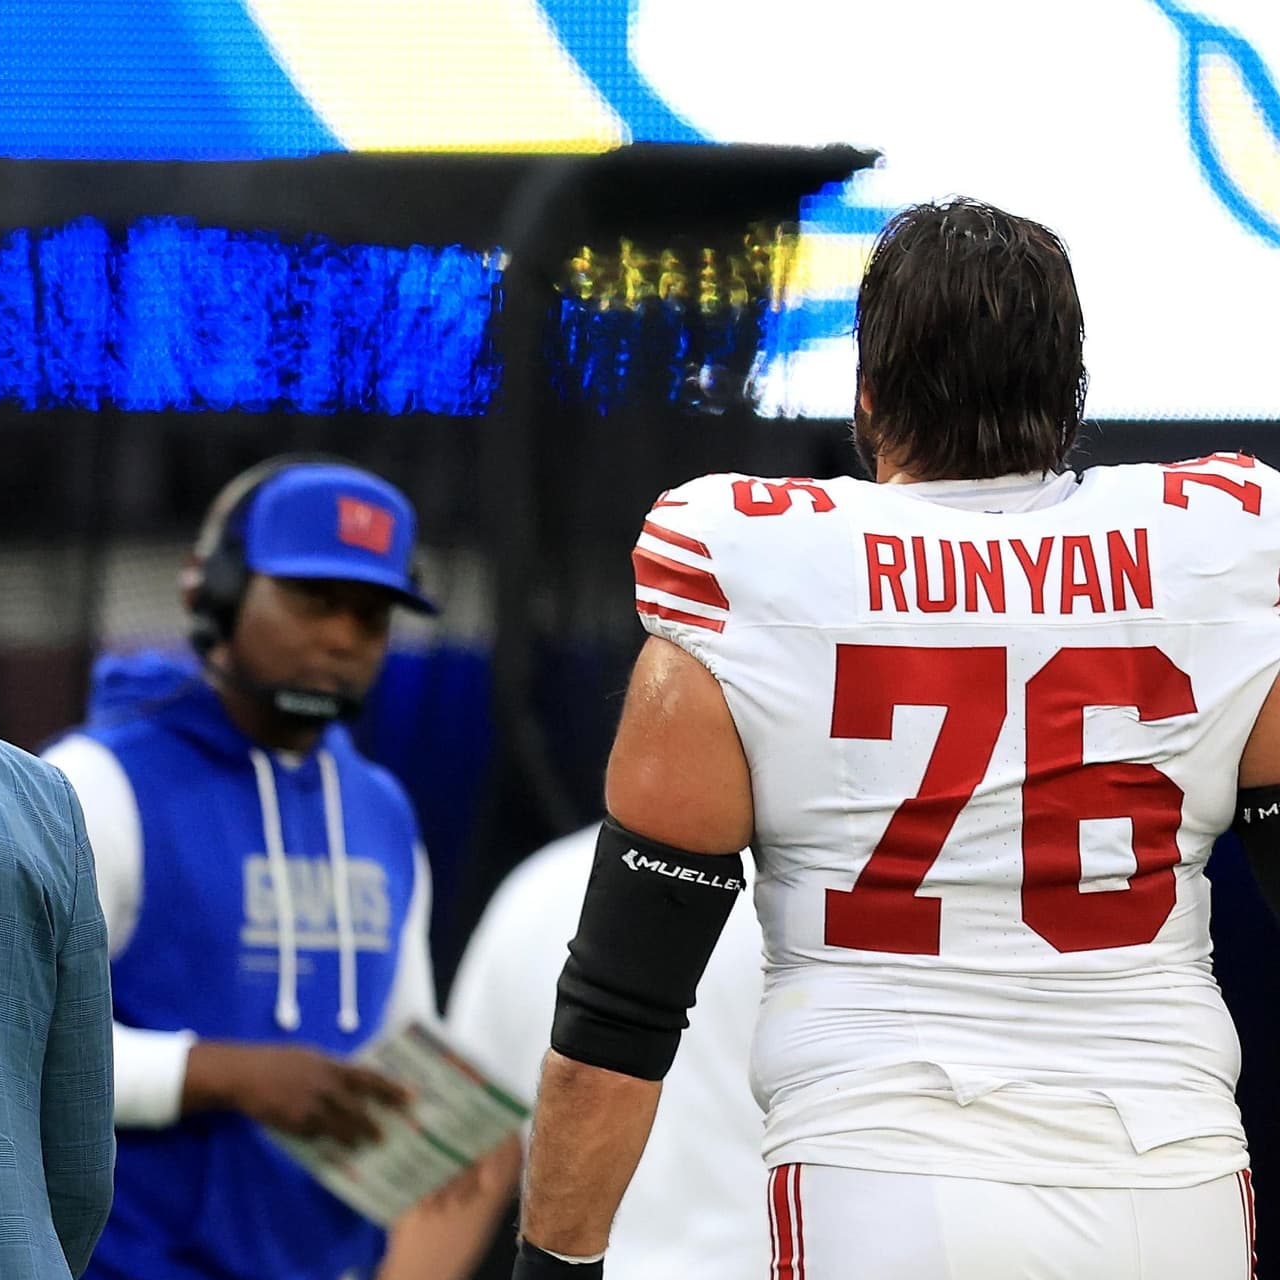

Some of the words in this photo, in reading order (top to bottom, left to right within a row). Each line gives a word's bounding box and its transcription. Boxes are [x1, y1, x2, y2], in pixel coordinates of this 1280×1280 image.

[863, 527, 1153, 614] RUNYAN
[824, 643, 1198, 955] 76
[1258, 803, 1280, 819] M
